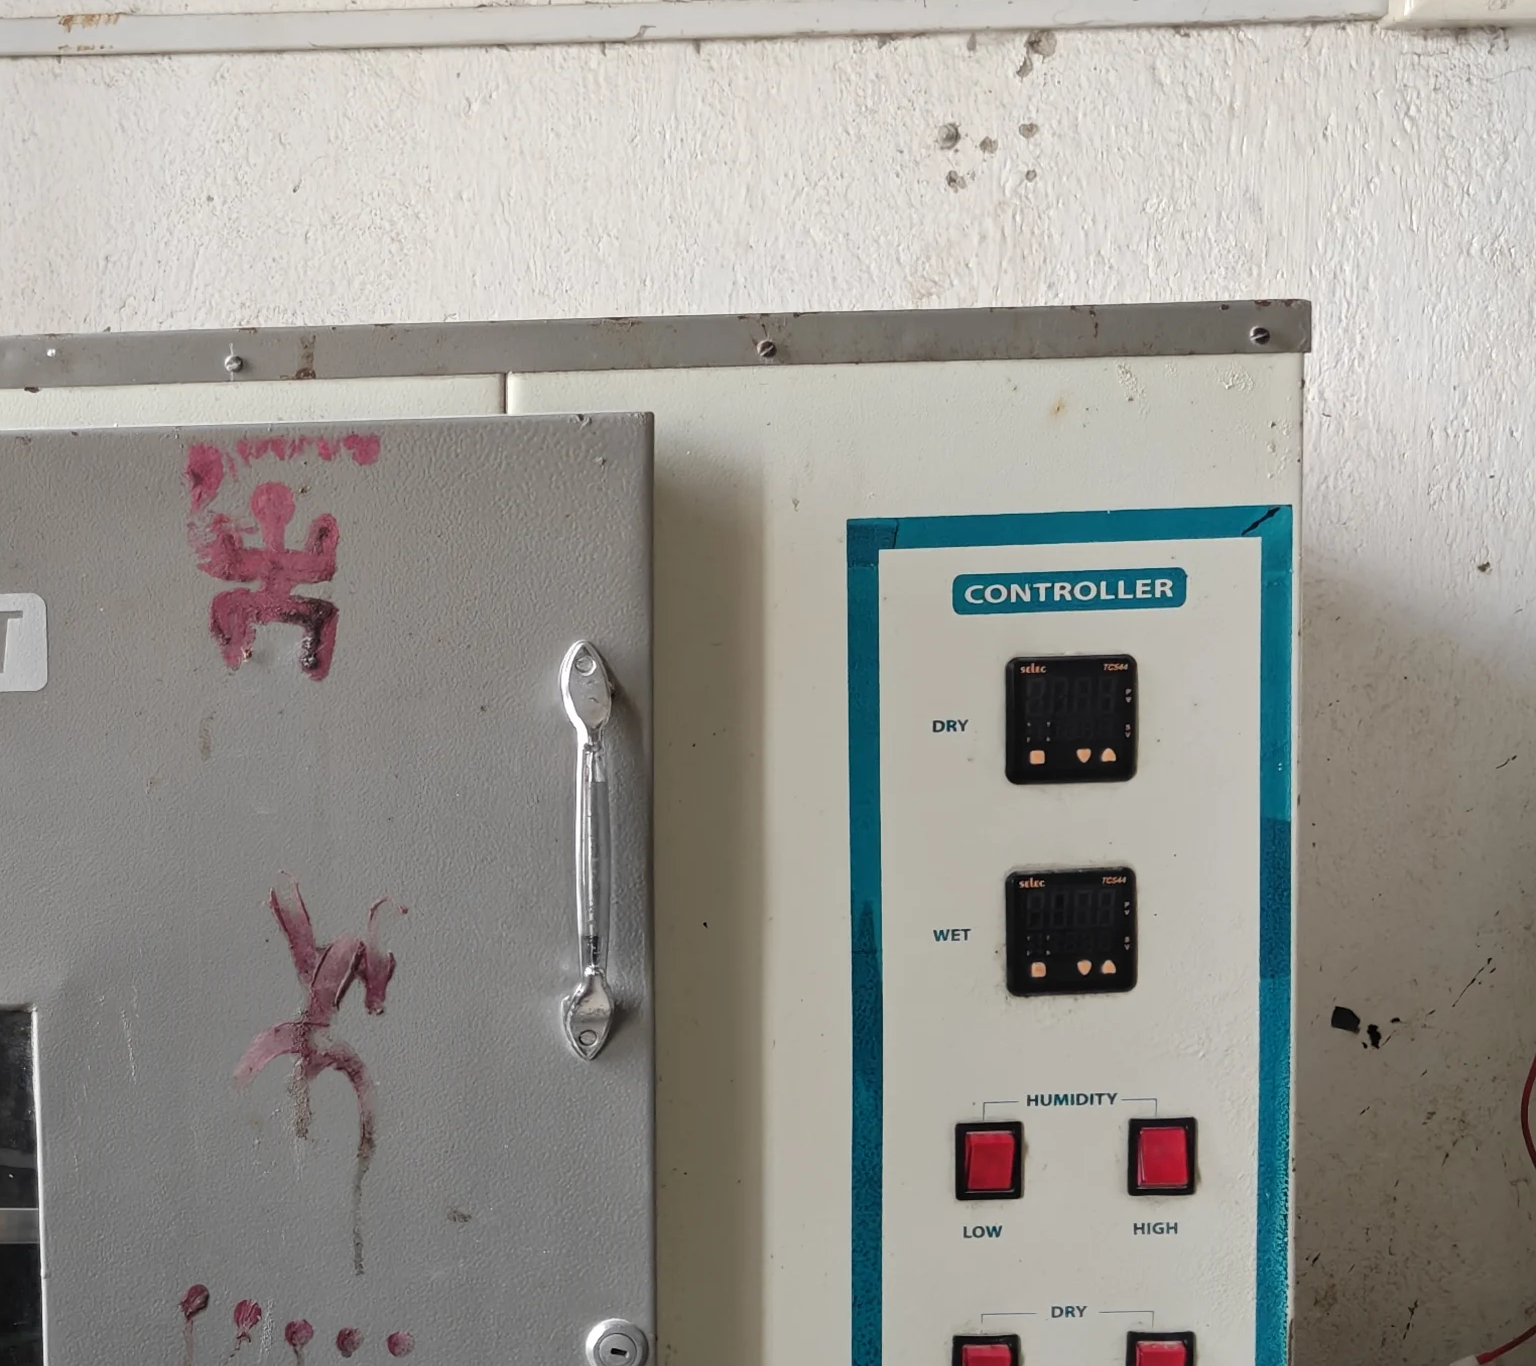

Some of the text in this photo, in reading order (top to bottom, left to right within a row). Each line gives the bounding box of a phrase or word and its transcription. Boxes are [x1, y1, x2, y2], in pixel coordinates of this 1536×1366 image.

[964, 578, 1175, 605] CONTROLLER
[932, 719, 970, 734] DRY
[933, 928, 971, 942] WET
[1026, 1092, 1119, 1108] HUMIDITY
[962, 1225, 1003, 1240] LOW
[1132, 1221, 1180, 1237] HIGH
[1050, 1305, 1088, 1320] DRY
